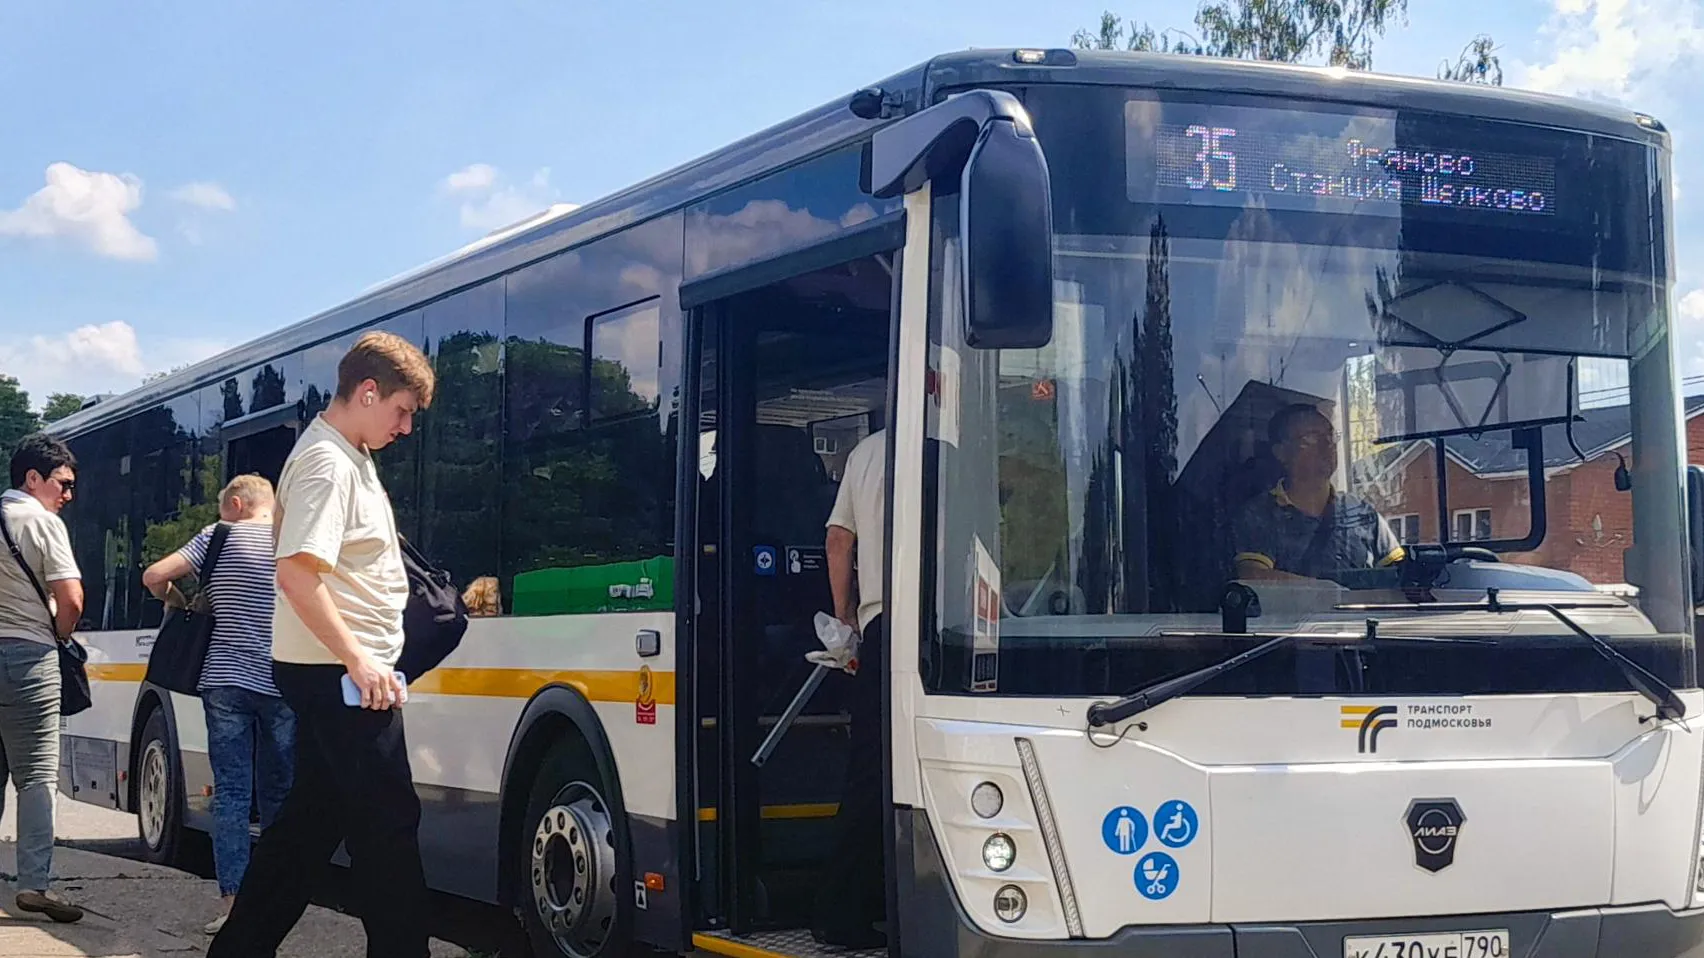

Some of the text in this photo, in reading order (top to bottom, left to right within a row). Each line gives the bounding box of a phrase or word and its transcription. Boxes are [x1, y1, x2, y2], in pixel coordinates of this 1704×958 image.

[1186, 125, 1236, 191] 35
[1271, 163, 1401, 201] Станция
[1407, 705, 1472, 715] ТРАНСПОРТ
[1407, 718, 1492, 729] ПОДМОСКОВЬЯ
[1464, 935, 1502, 958] 790
